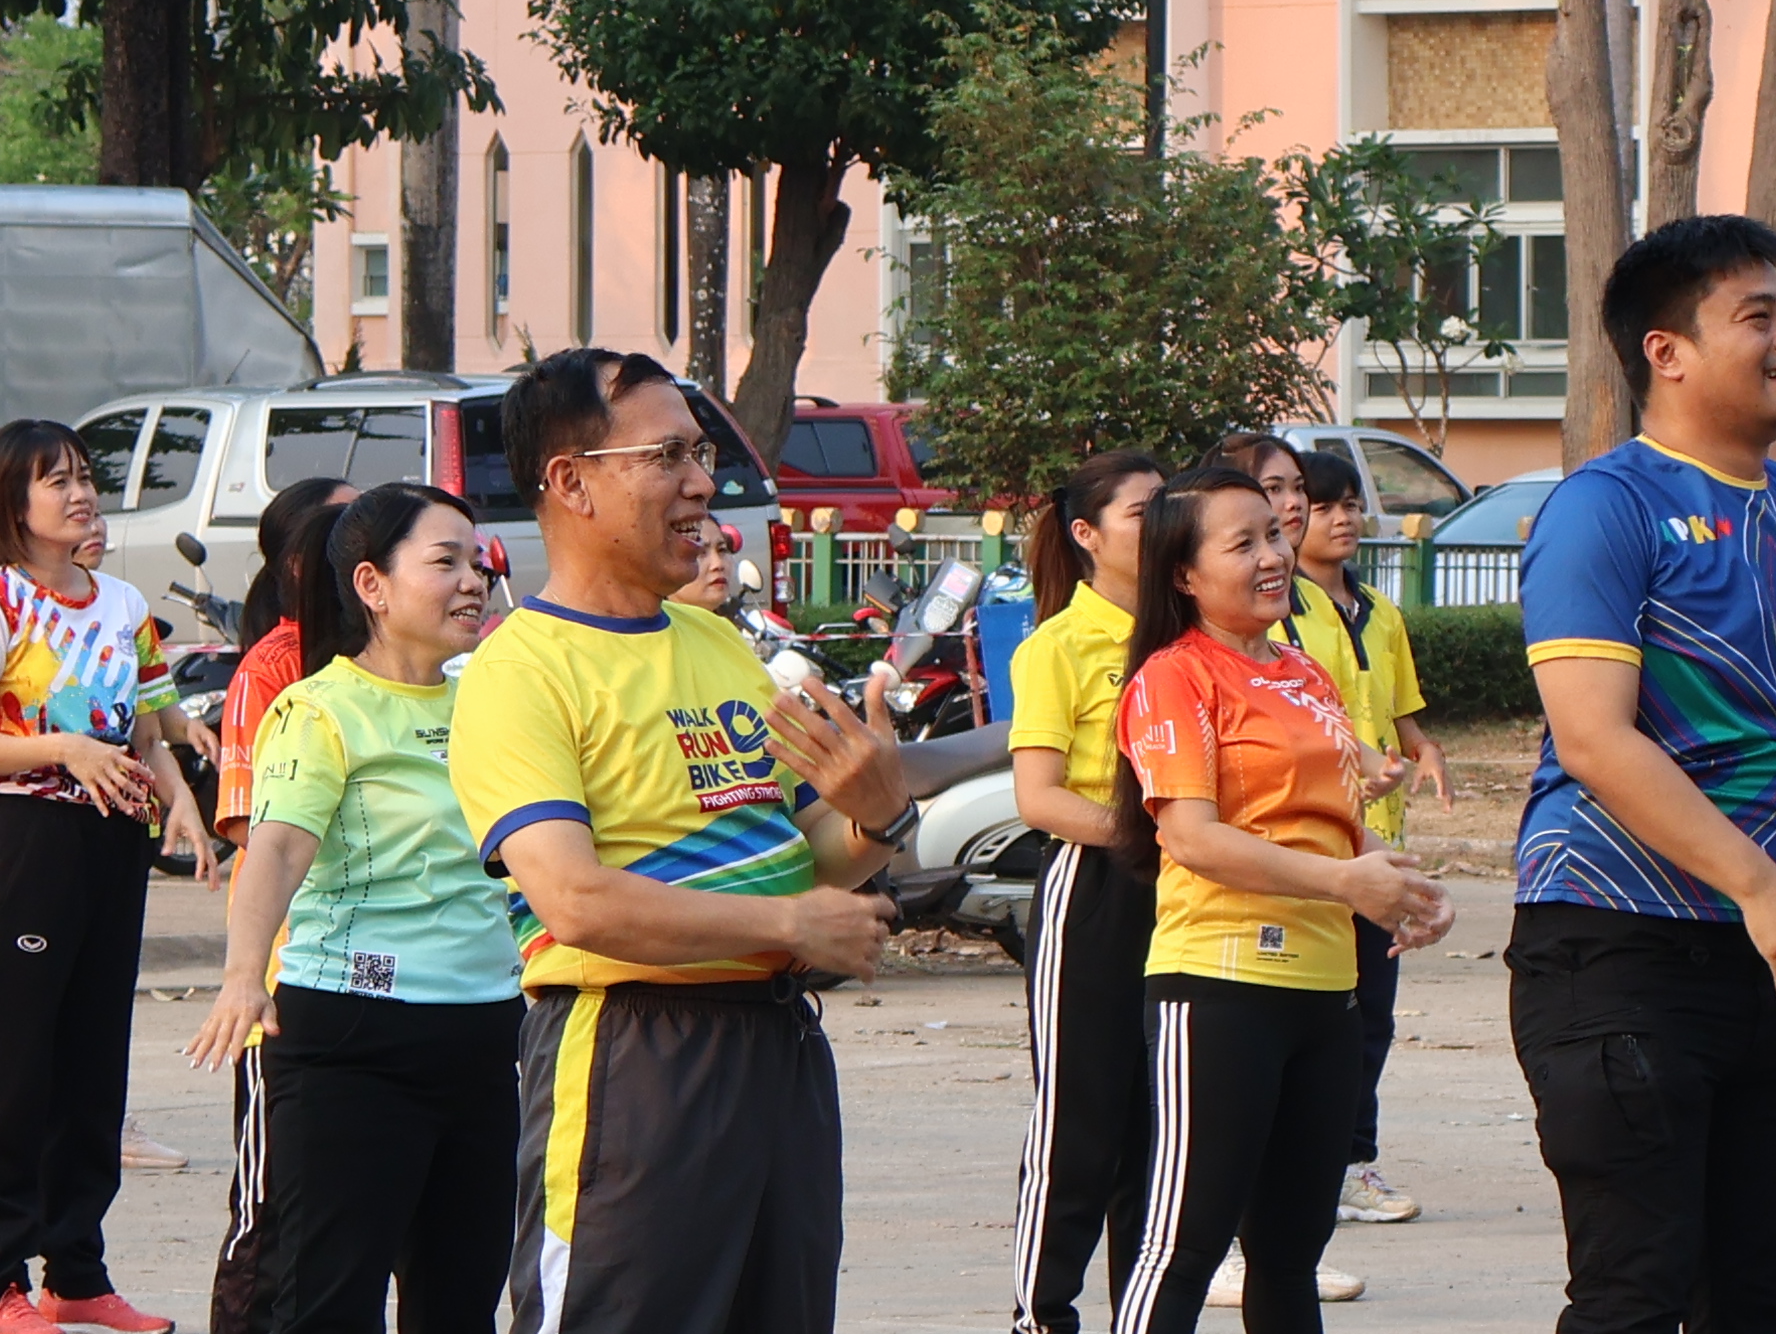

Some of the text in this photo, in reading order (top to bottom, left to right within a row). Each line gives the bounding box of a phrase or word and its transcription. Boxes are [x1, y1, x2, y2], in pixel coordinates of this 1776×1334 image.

[665, 707, 716, 729] WALK
[676, 730, 731, 760] RUN
[687, 760, 746, 791] BIKE
[701, 788, 756, 809] FIGHTING
